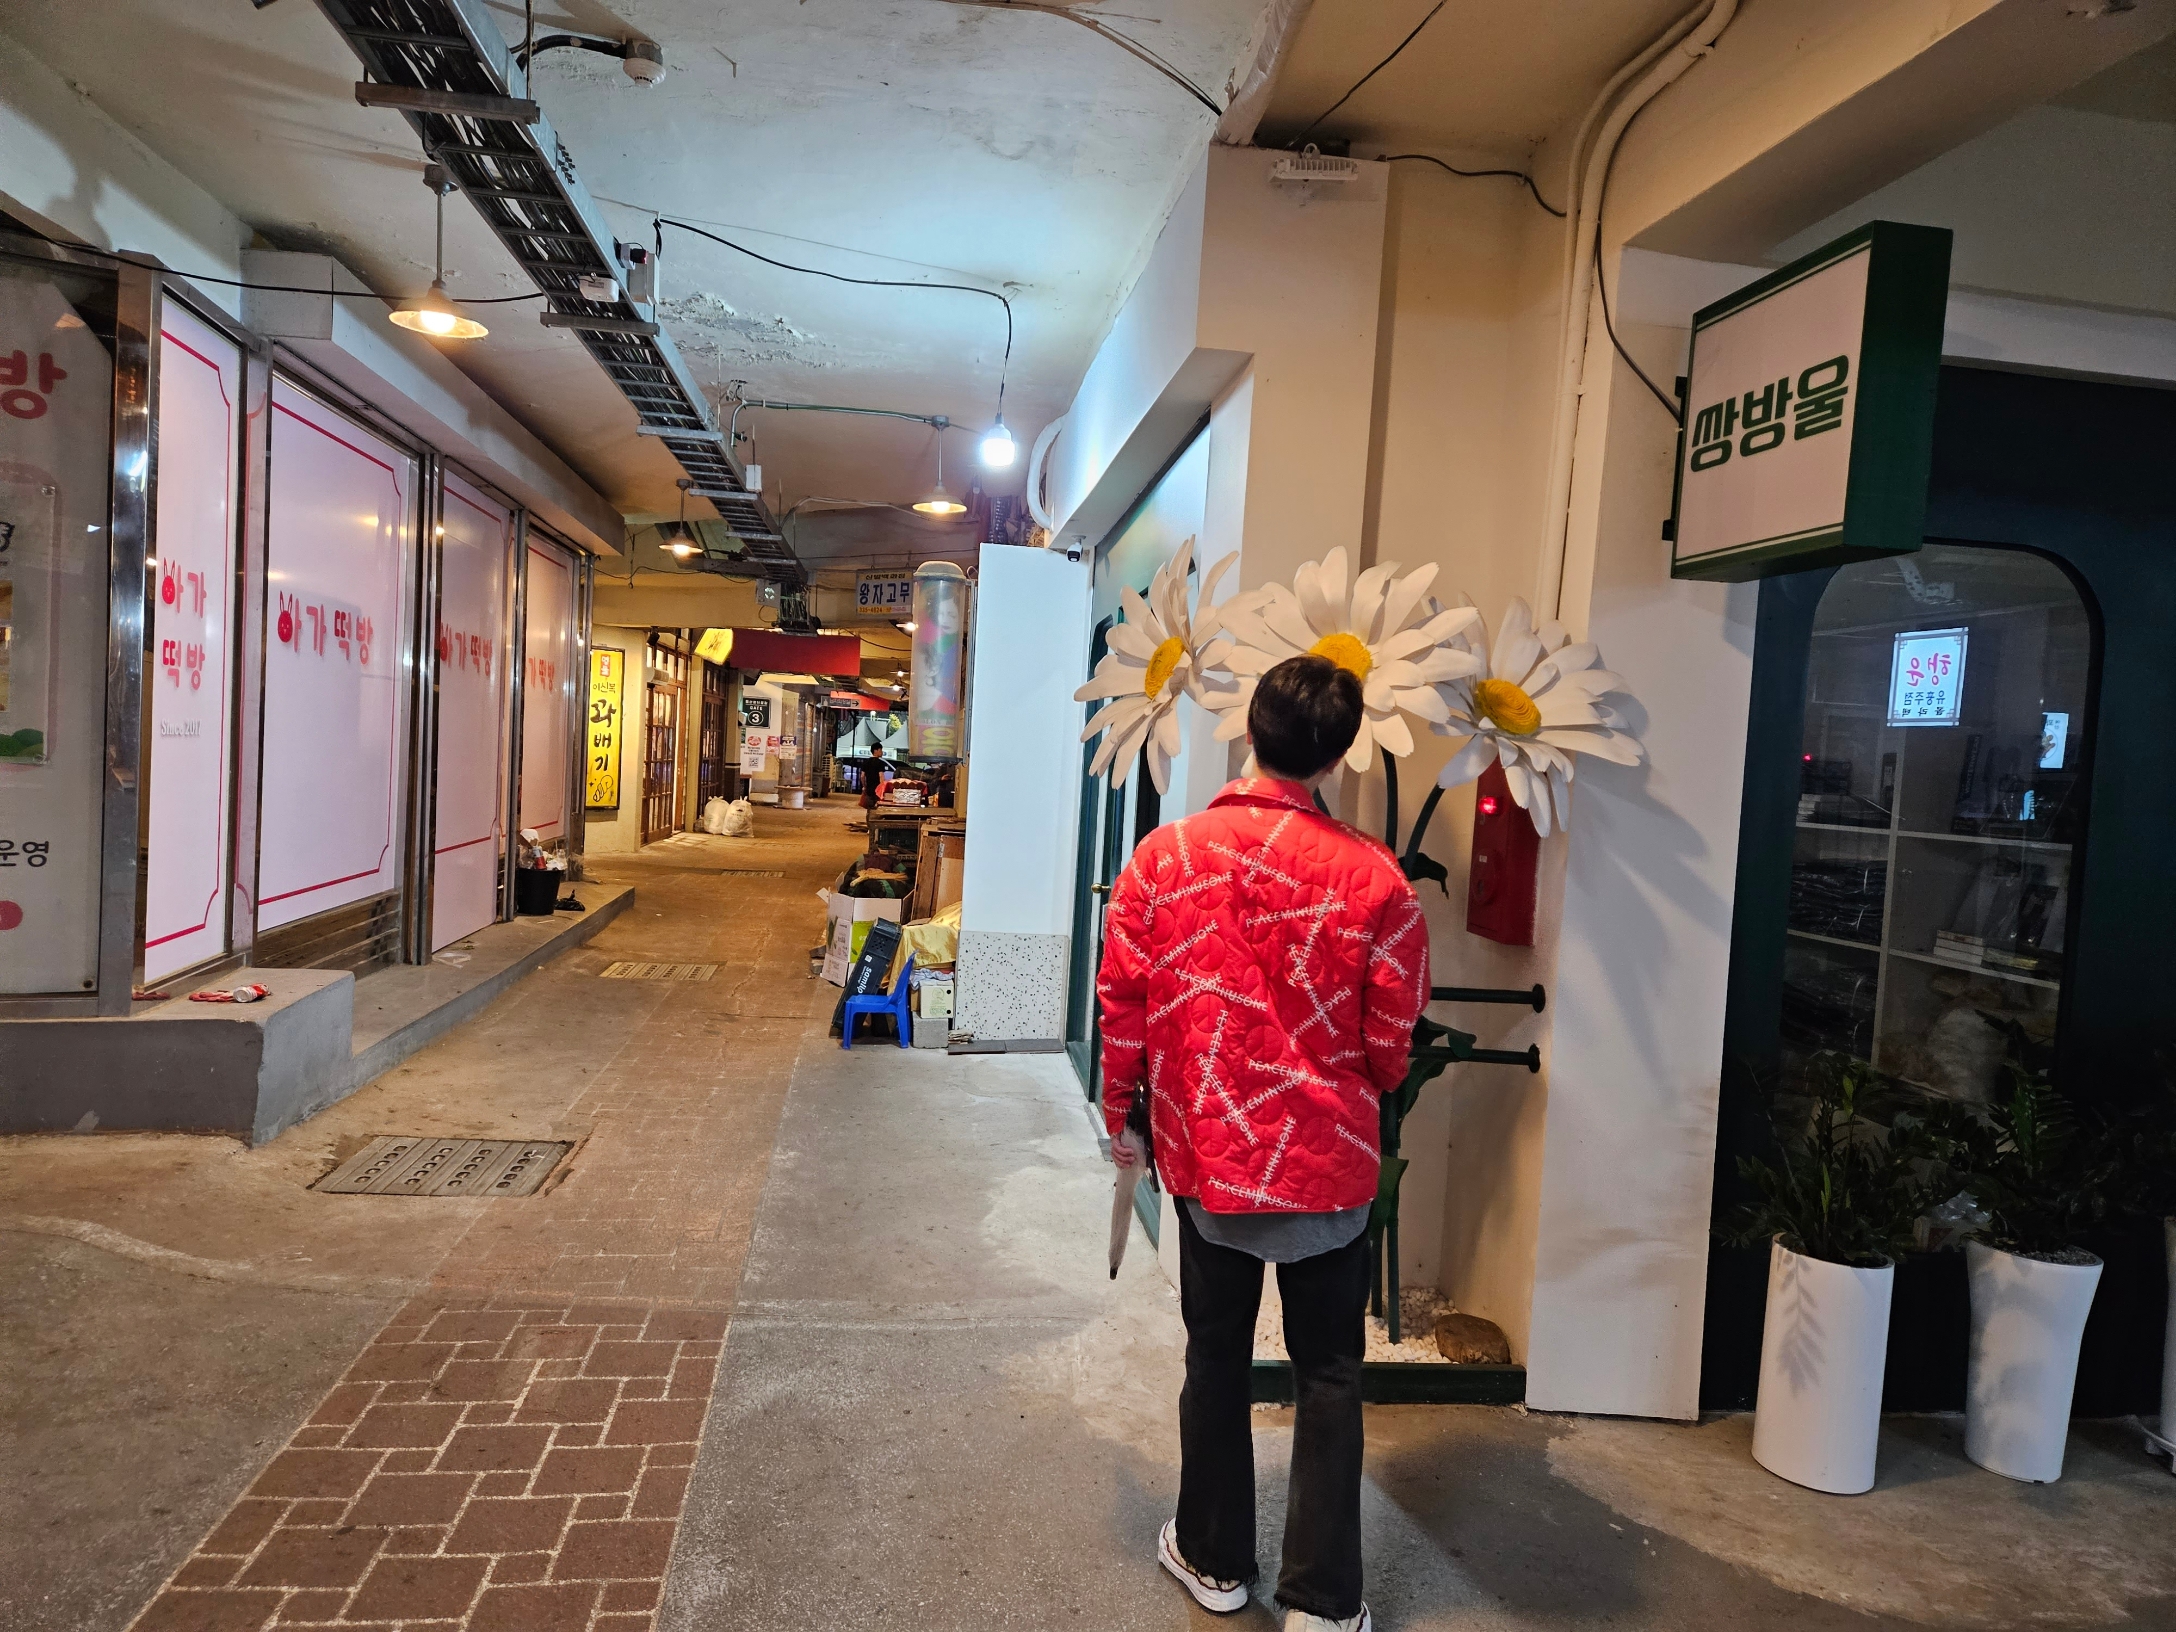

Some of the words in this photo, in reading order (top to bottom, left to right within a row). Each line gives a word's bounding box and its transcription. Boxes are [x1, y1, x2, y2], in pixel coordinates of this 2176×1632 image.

[1690, 354, 1849, 473] 쌍방울
[859, 582, 910, 605] 왕자고무
[334, 609, 374, 665] 떡방
[162, 639, 206, 691] 떡방
[751, 713, 760, 723] 3
